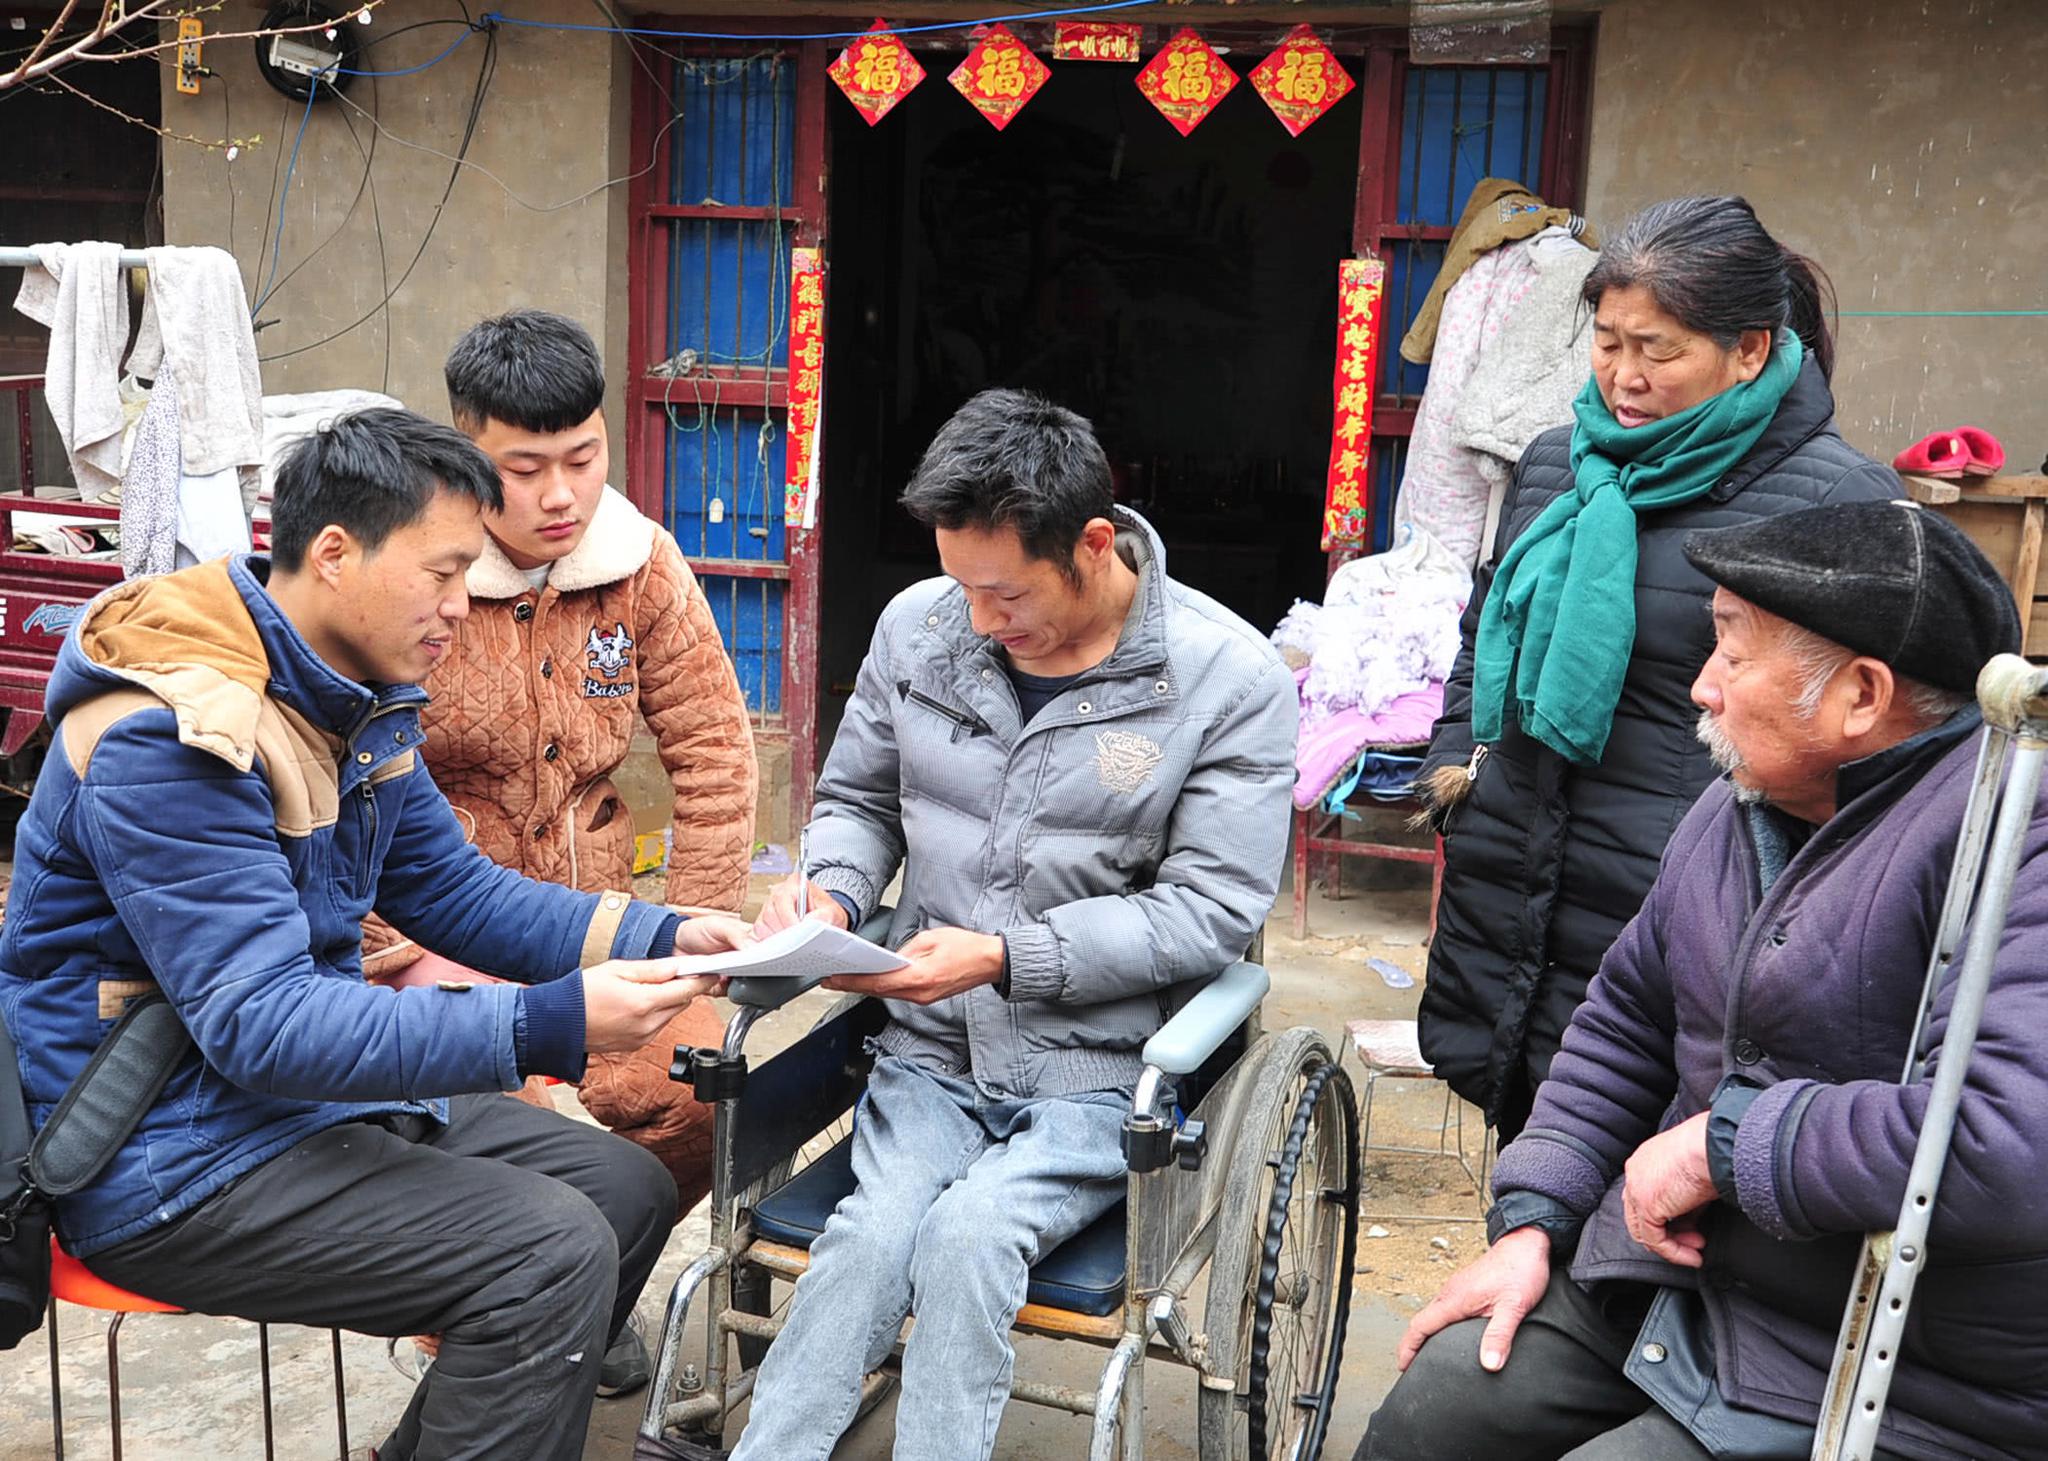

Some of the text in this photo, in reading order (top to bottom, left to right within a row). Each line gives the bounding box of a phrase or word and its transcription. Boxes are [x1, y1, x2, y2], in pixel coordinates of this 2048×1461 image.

[854, 43, 901, 94] 福
[976, 46, 1024, 97] 福
[1162, 49, 1213, 103] 福
[1276, 50, 1327, 105] 福
